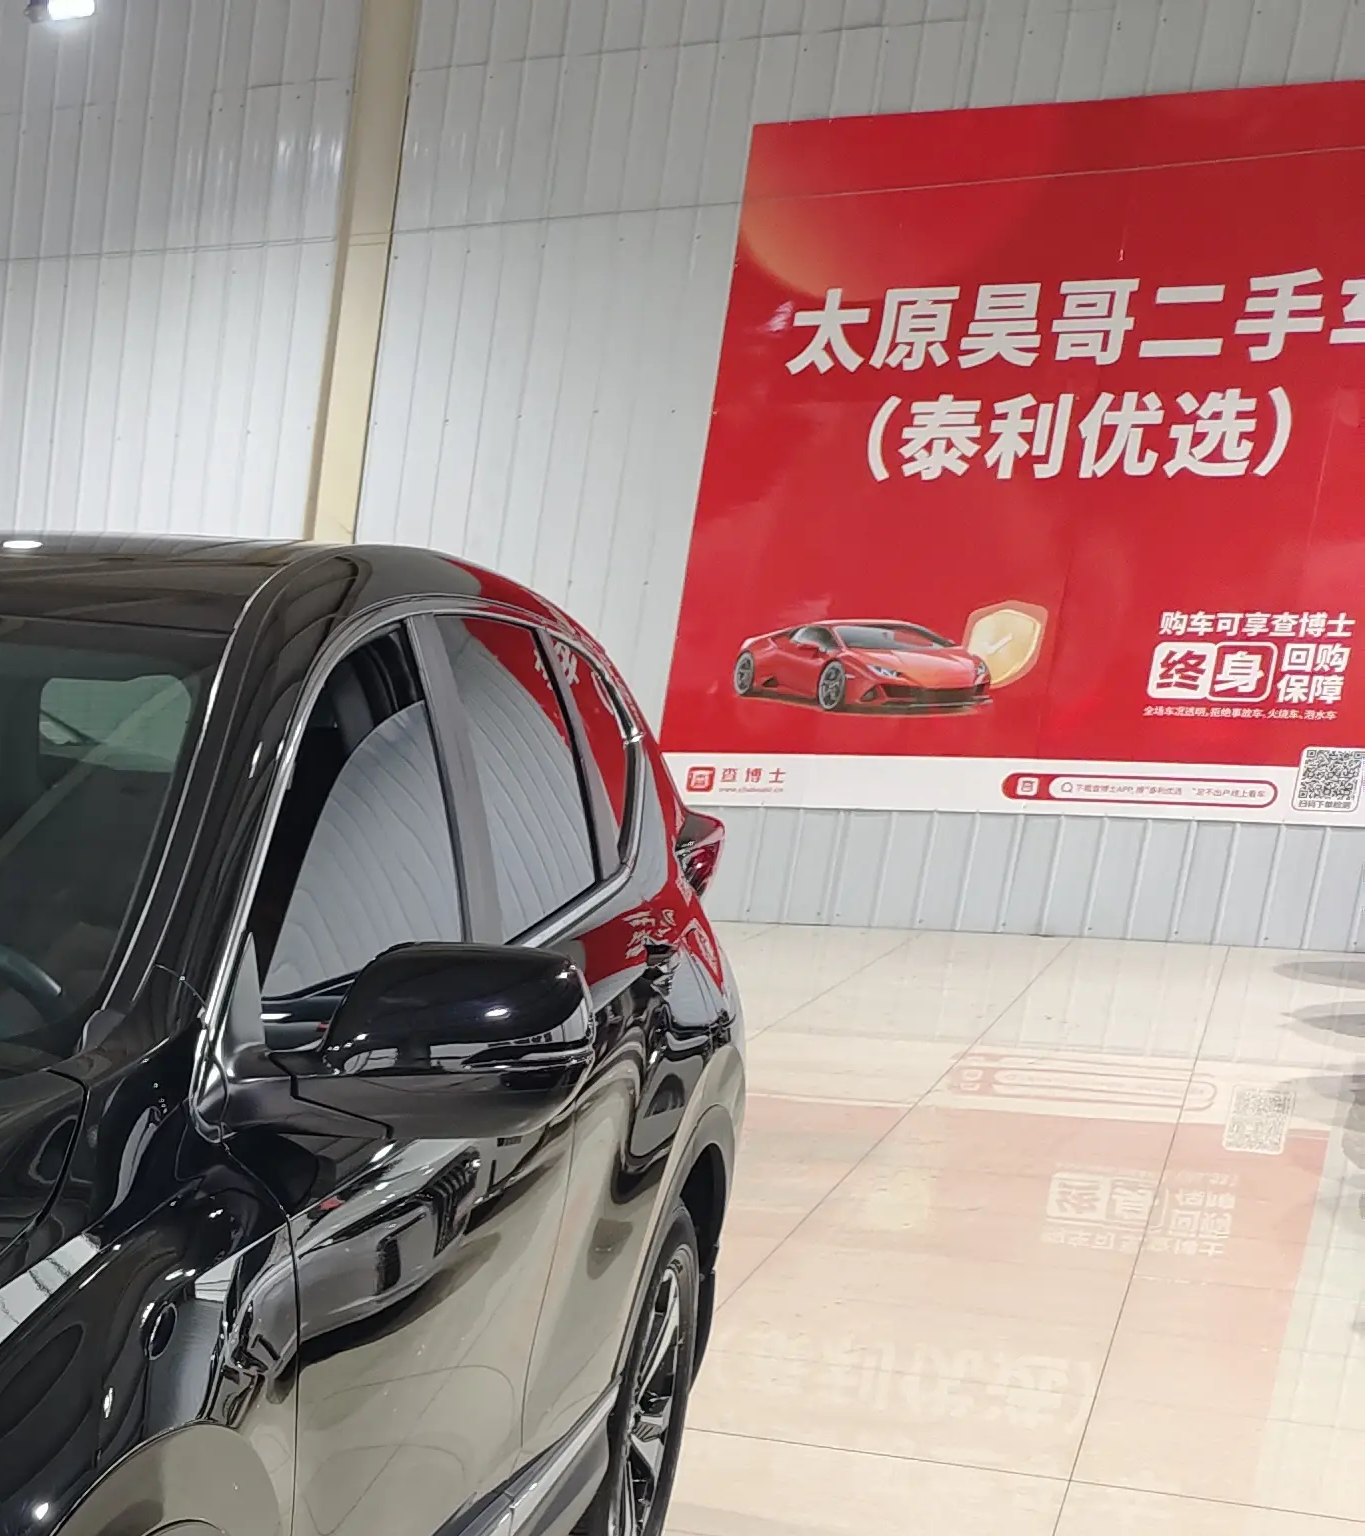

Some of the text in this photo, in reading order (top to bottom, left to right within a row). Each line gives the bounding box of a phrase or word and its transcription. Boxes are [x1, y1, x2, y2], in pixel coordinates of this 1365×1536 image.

[1159, 611, 1356, 637] 购车可享查博士
[1155, 649, 1265, 693] 终身
[1281, 643, 1351, 673] 回购
[1277, 674, 1345, 704] 保障
